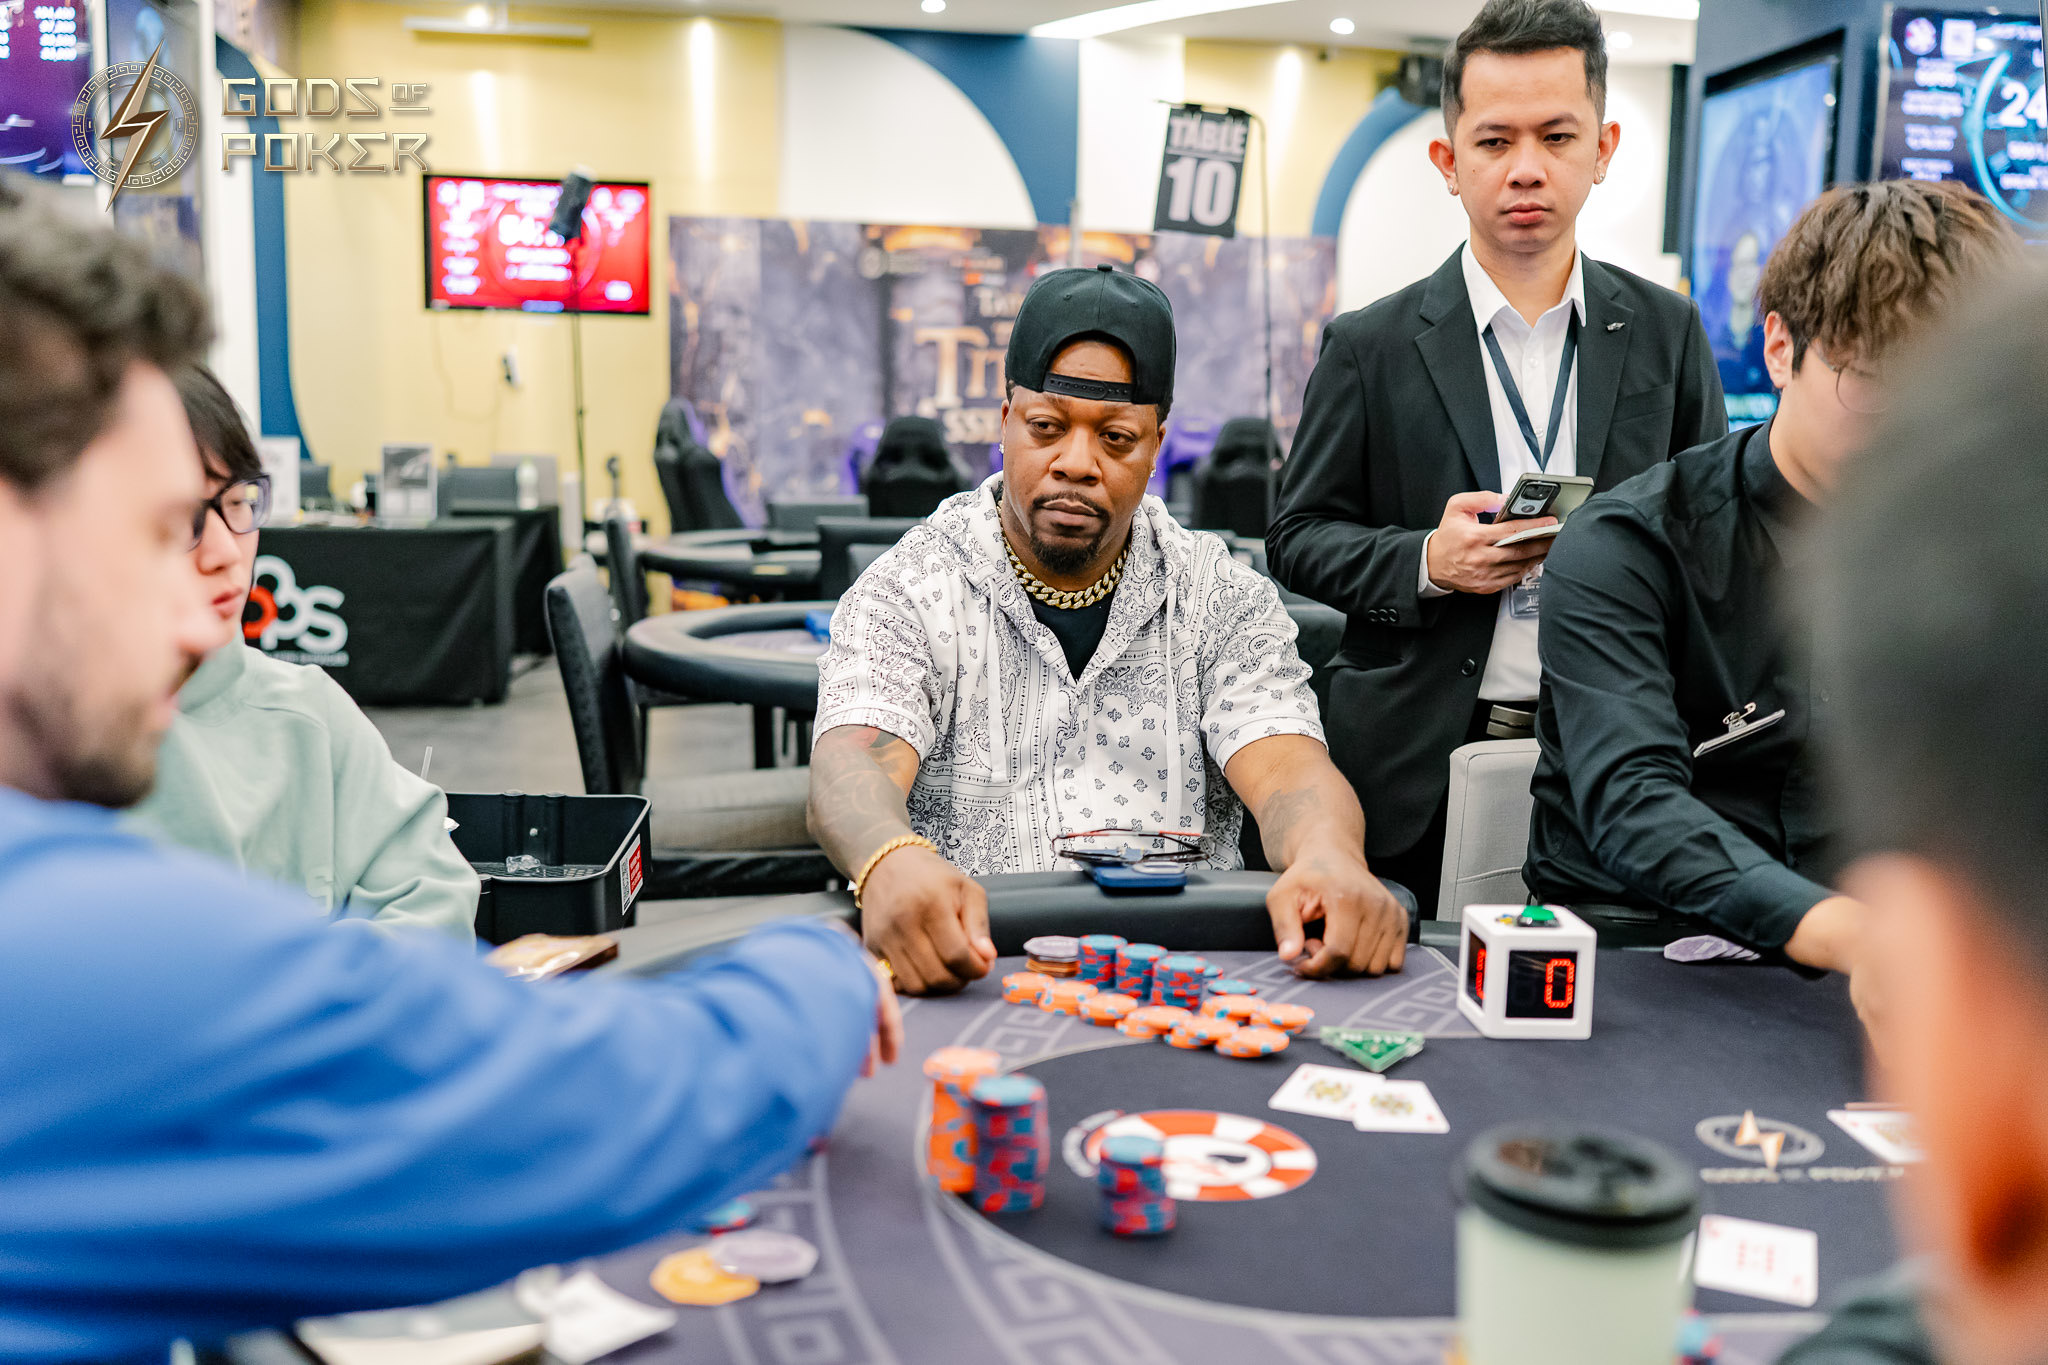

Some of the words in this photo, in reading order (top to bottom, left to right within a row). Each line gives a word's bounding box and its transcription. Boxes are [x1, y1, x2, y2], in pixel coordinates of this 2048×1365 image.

[1168, 114, 1248, 155] TABLE
[1165, 156, 1237, 226] 10
[1544, 958, 1575, 1008] 0
